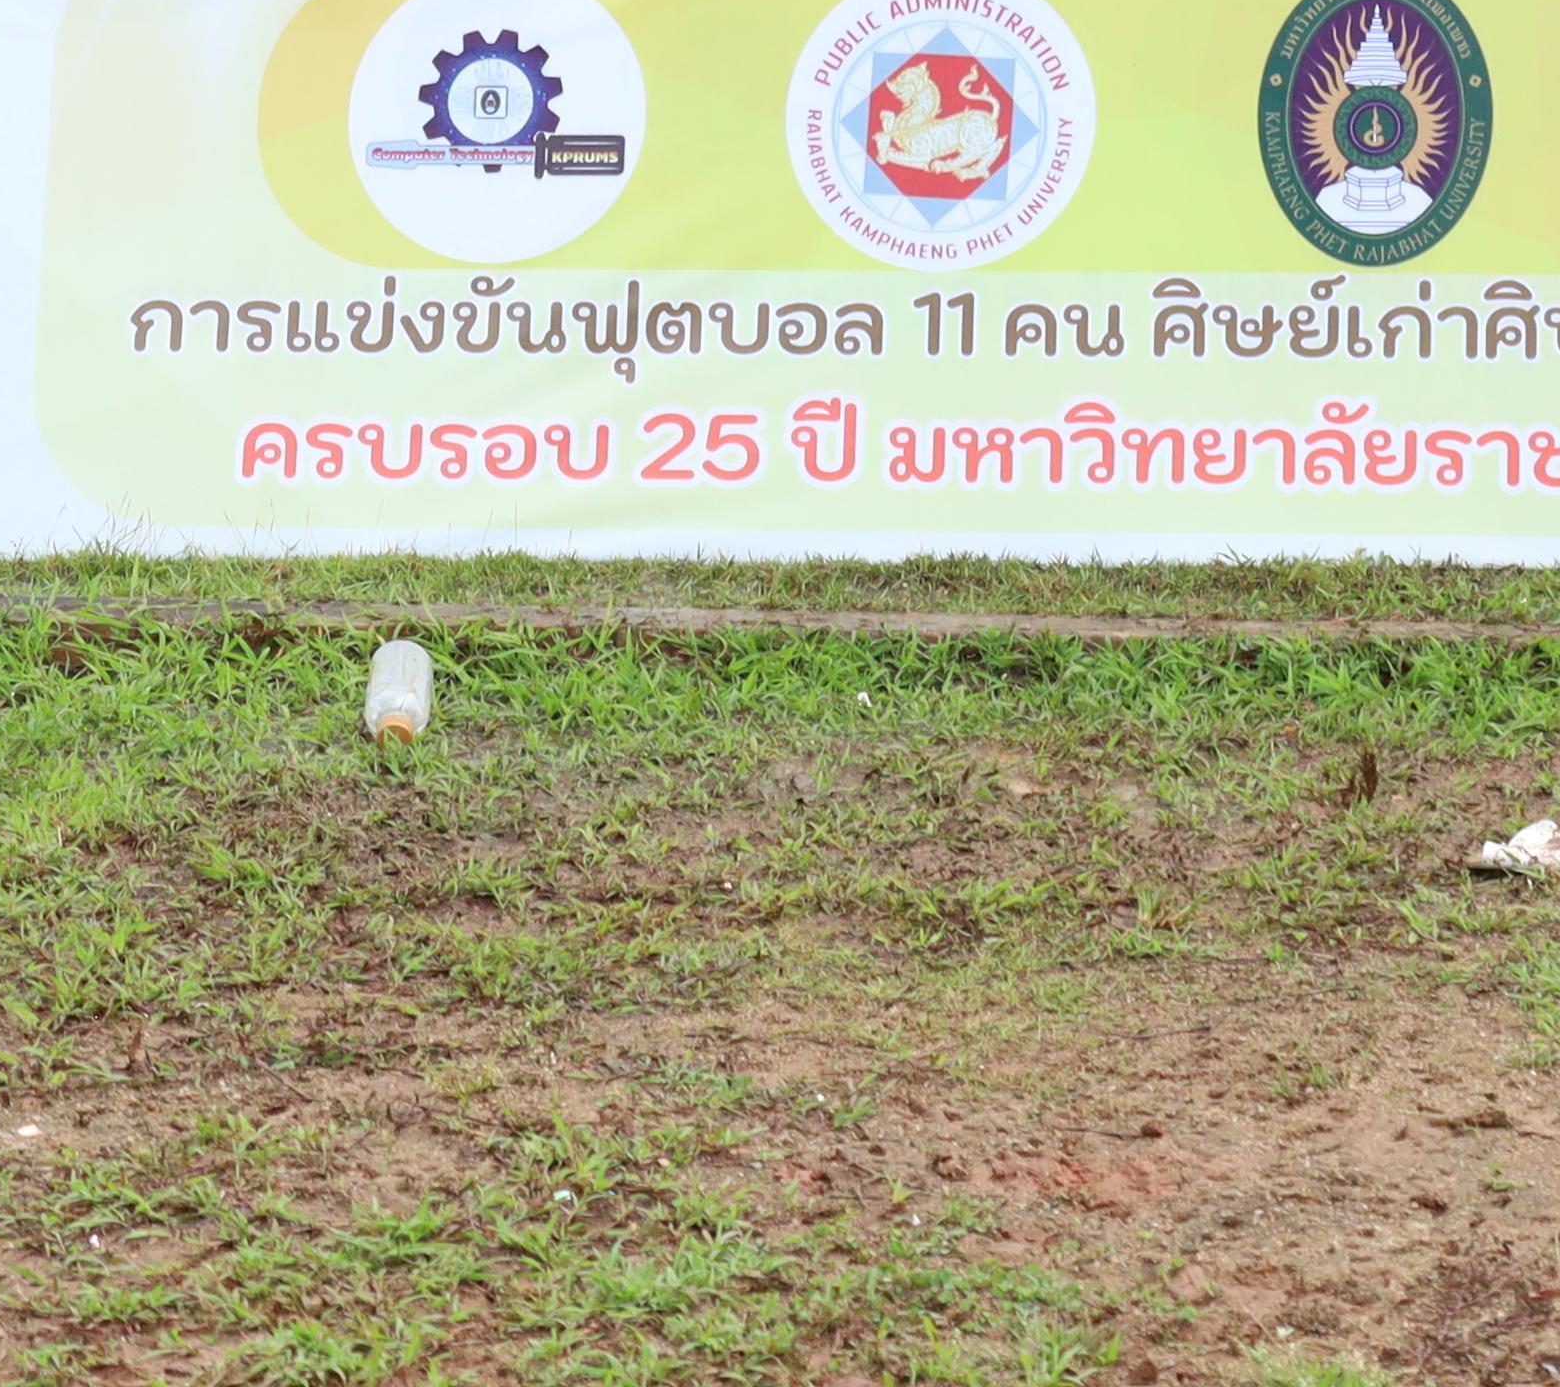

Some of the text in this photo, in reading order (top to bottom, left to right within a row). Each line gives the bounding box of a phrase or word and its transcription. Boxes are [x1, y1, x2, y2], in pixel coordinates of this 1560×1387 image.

[814, 11, 882, 87] PUBLIC
[371, 147, 535, 163] Computer Technology
[551, 150, 619, 164] KPRUMS
[840, 205, 958, 259] KAMPHAENG
[966, 222, 1014, 256] PHET
[1017, 117, 1073, 225] UNIVERSITY
[1265, 111, 1486, 265] KAMPHAENG PHET RAJABHAT UNIVERSITY
[130, 275, 884, 383] การแข่งขันฟุตบอล
[914, 292, 975, 357] 11
[1004, 304, 1125, 358] คน
[241, 423, 610, 480] ครบรอบ
[640, 413, 761, 481] 25
[792, 397, 857, 483] ปี
